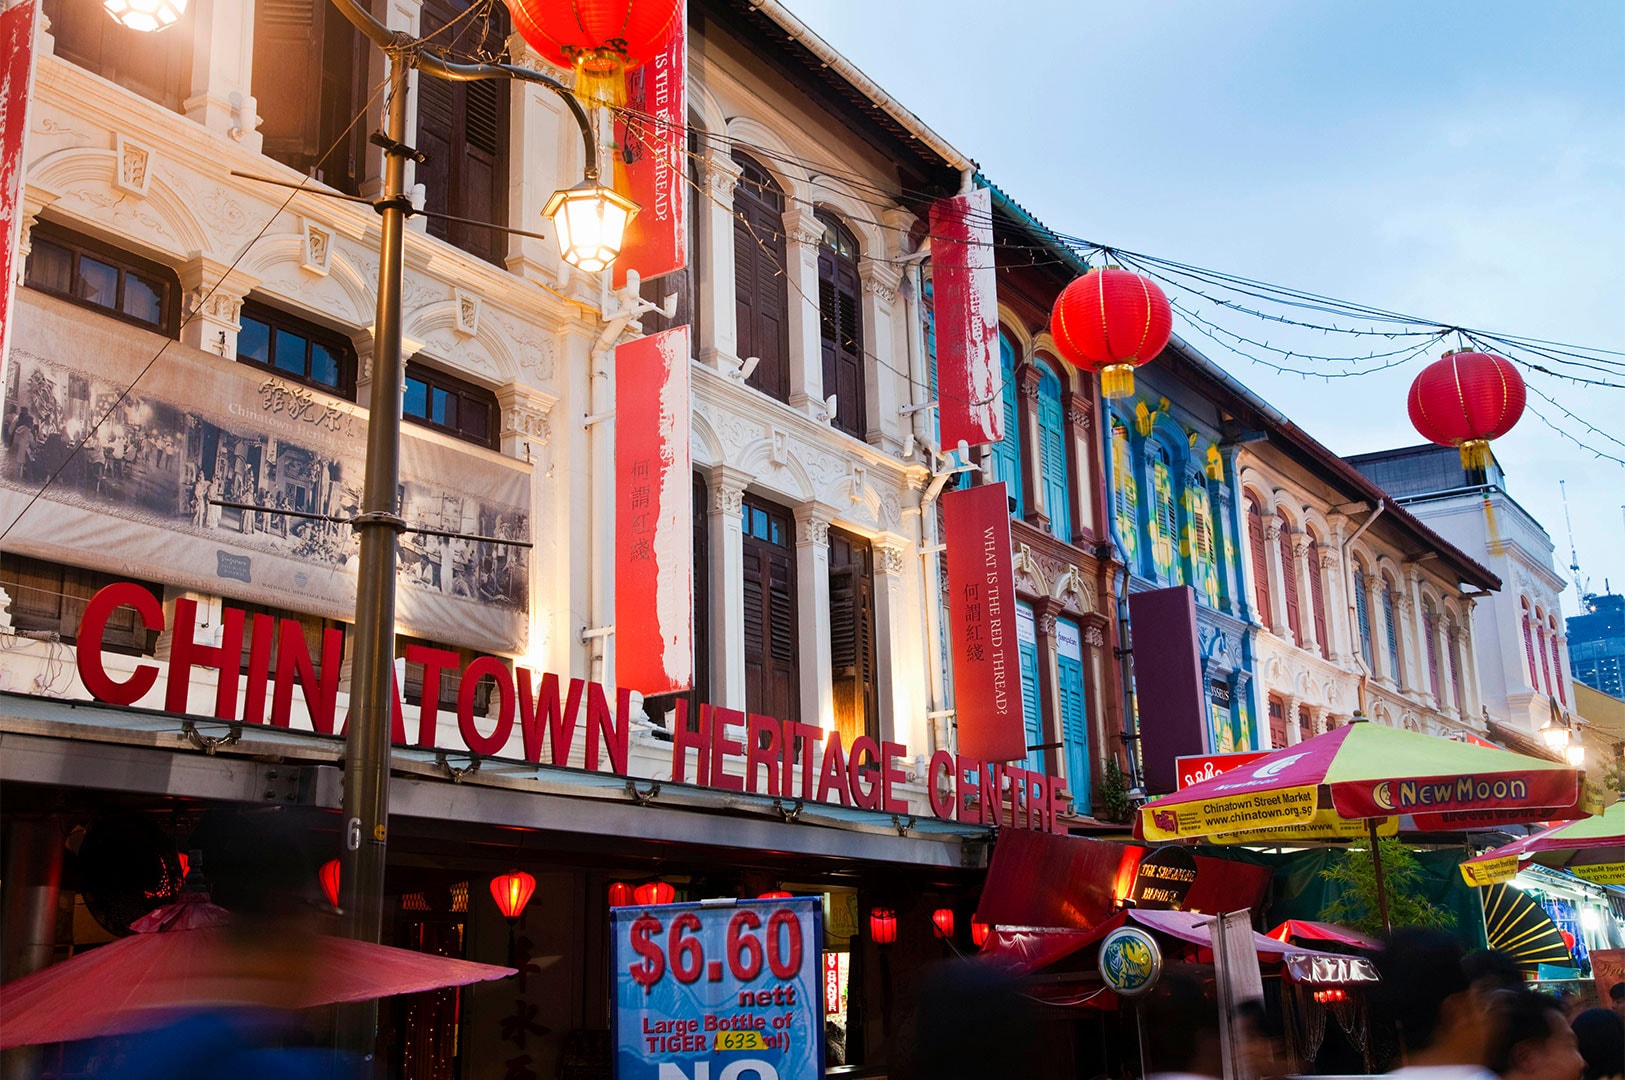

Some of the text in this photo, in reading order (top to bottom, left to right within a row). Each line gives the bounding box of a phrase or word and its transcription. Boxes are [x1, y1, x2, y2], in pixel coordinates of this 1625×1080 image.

[655, 51, 668, 69] IS
[655, 69, 668, 107] THE
[228, 402, 293, 431] Chinatown
[297, 424, 344, 447] Heritage
[132, 566, 158, 579] joint
[162, 573, 198, 588] project
[201, 580, 214, 592] by
[216, 583, 267, 603] Singapore
[270, 595, 310, 612] Tourism
[312, 604, 342, 617] Board
[261, 582, 291, 593] NATIONAL
[983, 525, 1008, 716] WHAT IS THE RED THREAD?
[77, 582, 1069, 834] CHINTOWN HERITAGE CENTRE
[1203, 792, 1312, 815] Chinatown Street Market
[1205, 805, 1313, 826] www.chinatown.org.sg
[347, 817, 362, 849] 6
[629, 908, 804, 994] $6.60
[738, 985, 796, 1008] nett
[642, 1011, 793, 1038] Large Bottle of
[645, 1034, 707, 1053] TIGER
